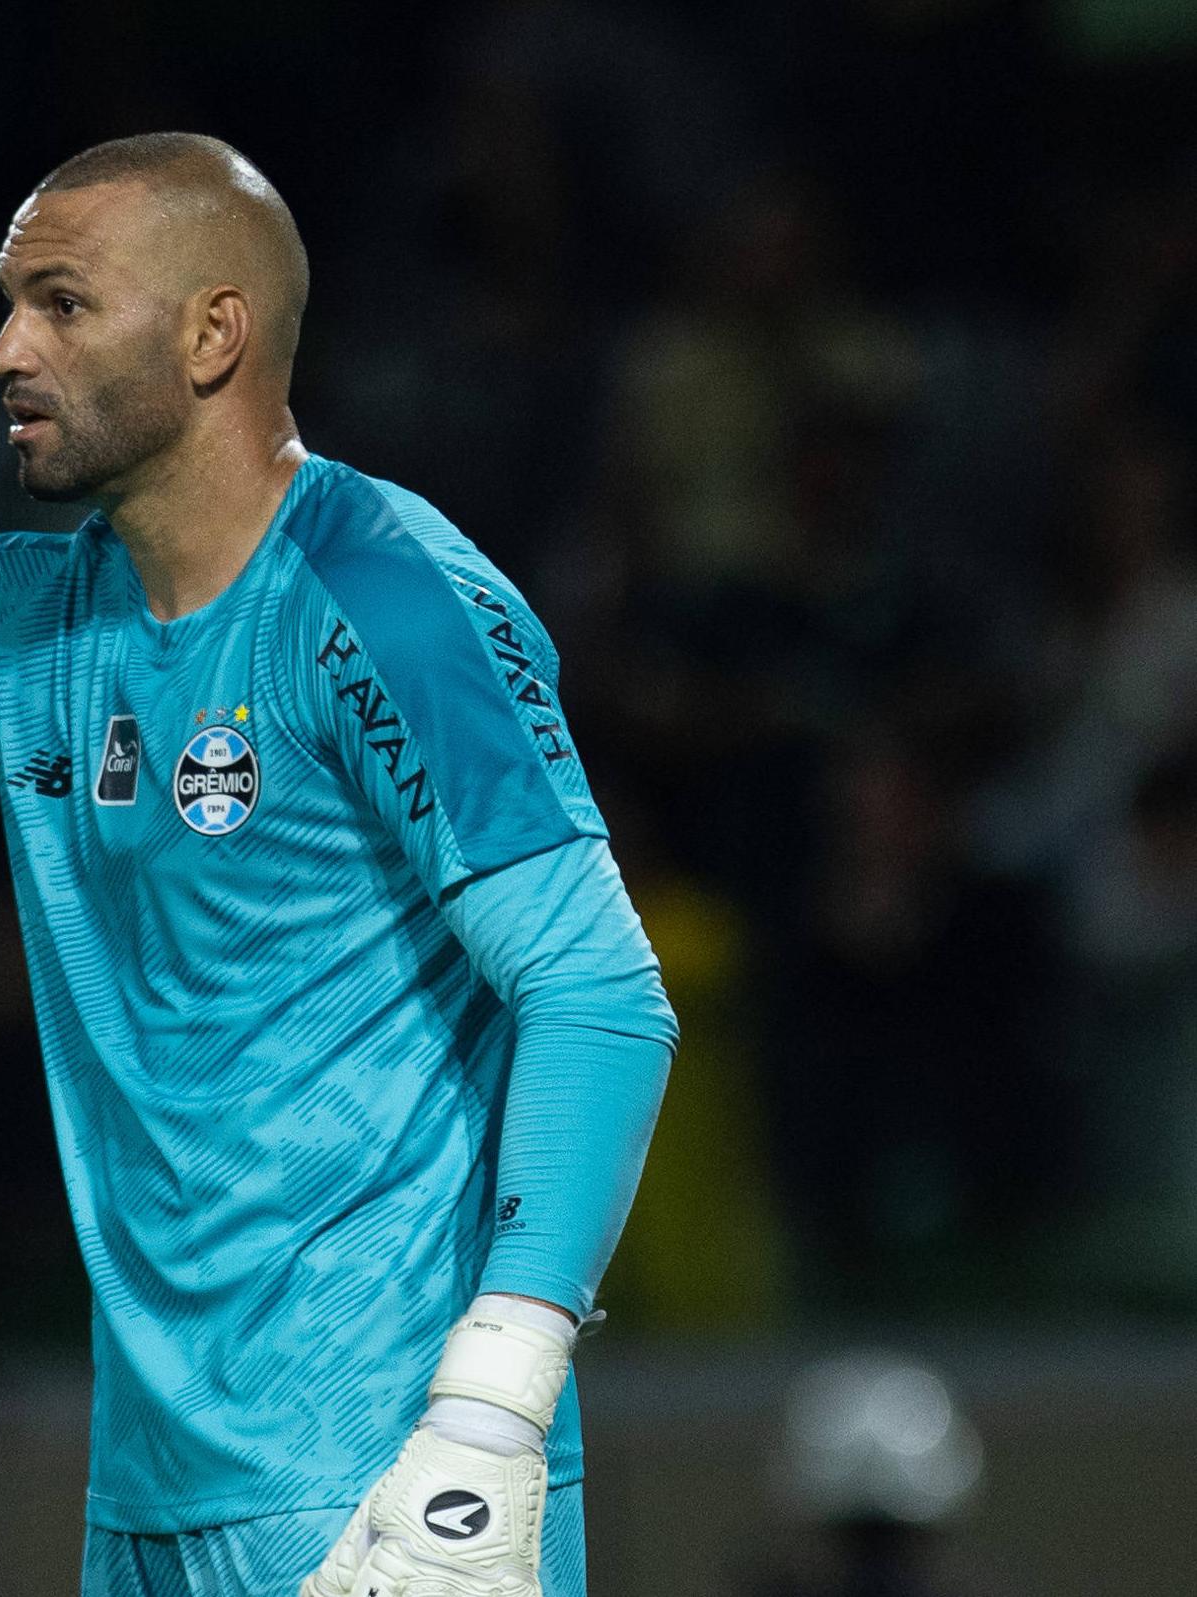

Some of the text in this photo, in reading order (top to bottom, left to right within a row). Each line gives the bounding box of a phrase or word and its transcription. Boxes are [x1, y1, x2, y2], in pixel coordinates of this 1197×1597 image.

[316, 617, 435, 824] HAVAN
[107, 754, 134, 773] Coral
[179, 767, 253, 796] GRÊMIO
